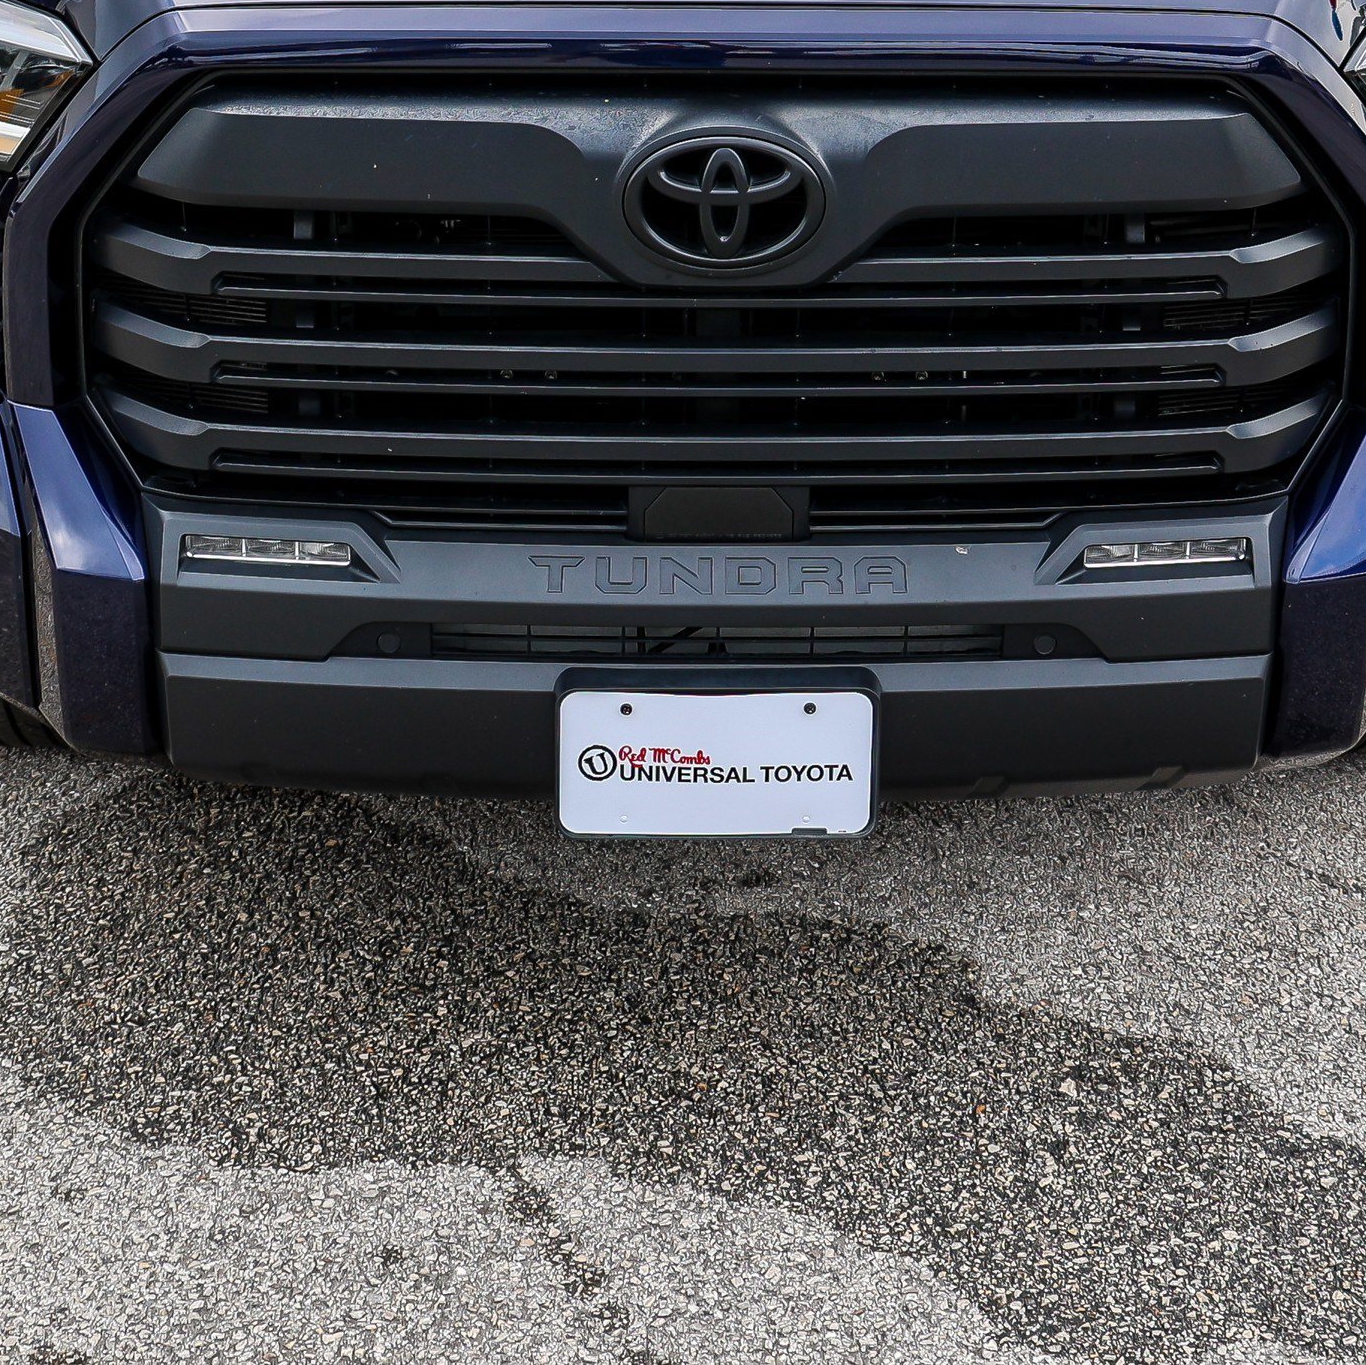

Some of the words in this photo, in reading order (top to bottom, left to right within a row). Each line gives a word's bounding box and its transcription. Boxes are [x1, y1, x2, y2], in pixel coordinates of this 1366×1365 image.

[527, 554, 908, 595] TUNDRA
[618, 745, 647, 768] Red
[619, 764, 756, 784] UNIVERSAL
[759, 764, 854, 783] TOYOTA
